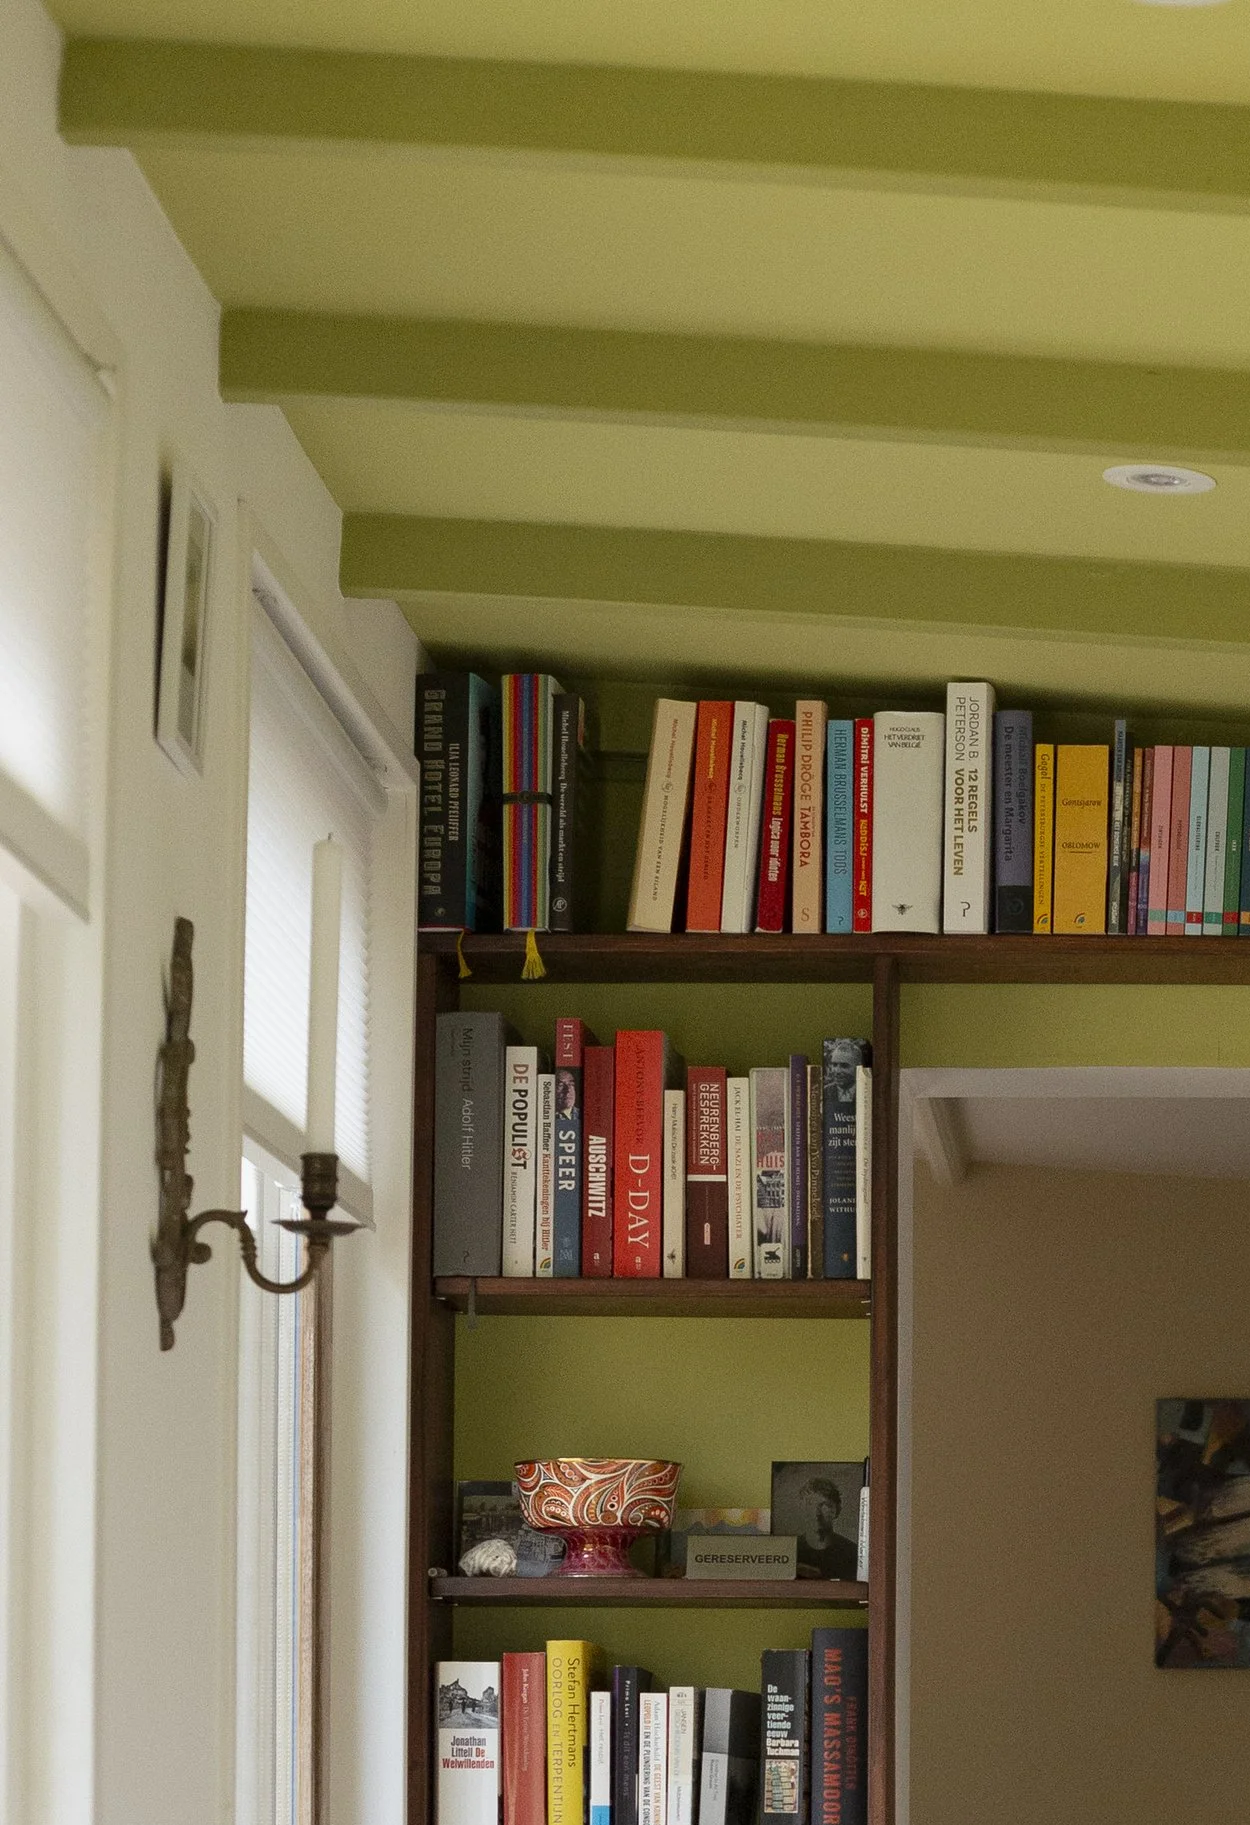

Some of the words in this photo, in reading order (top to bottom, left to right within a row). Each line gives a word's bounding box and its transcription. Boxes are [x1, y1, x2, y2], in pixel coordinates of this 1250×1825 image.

[560, 711, 570, 735] Michel
[800, 711, 813, 751] PHILIP
[953, 697, 965, 762] PETERSON
[967, 697, 979, 747] JORDAN
[1003, 727, 1014, 742] De
[448, 743, 460, 759] ILJA
[558, 736, 569, 780] Houellebecq
[834, 729, 847, 770] HERMAN
[968, 751, 978, 761] B.
[1037, 753, 1051, 779] Gogol
[448, 762, 460, 798] LEONARD
[559, 783, 567, 793] De
[799, 754, 816, 801] DRÖGE
[952, 768, 965, 805] VOOR
[967, 769, 978, 782] 12
[558, 794, 567, 818] wereld
[833, 774, 847, 845] BRUSSELMANS
[952, 811, 964, 833] HET
[967, 784, 978, 832] REGELS
[557, 831, 566, 852] markt
[558, 819, 566, 830] als
[799, 806, 812, 868] TAMBORA
[1001, 807, 1015, 863] Margarita
[557, 854, 564, 863] en
[833, 849, 846, 875] TOOS
[952, 835, 963, 876] LEVEN
[556, 864, 565, 883] strijd
[460, 1028, 475, 1058] Mijn
[562, 1024, 575, 1061] FEST
[460, 1060, 475, 1092] strijd
[512, 1063, 529, 1085] DE
[461, 1098, 475, 1133] Adolf
[542, 1081, 552, 1119] Sebastian
[542, 1122, 551, 1152] Haffner
[699, 1084, 710, 1164] GESPREKKEN
[709, 1083, 720, 1171] NEURENBERG-
[461, 1135, 475, 1170] Hitler
[557, 1130, 577, 1190] SPEER
[588, 1135, 606, 1218] AUSCHWITZ
[627, 1153, 651, 1249] D-DAY
[694, 1553, 790, 1565] GERESERVEERD
[552, 1657, 563, 1719] OORLOG
[567, 1657, 581, 1699] Stefan
[767, 1684, 778, 1693] De
[823, 1647, 841, 1704] MAO'S
[450, 1736, 487, 1746] Jonathan
[552, 1723, 560, 1737] EN
[567, 1703, 580, 1768] Hertmans
[766, 1730, 788, 1738] eeuw
[766, 1738, 800, 1747] Barbara
[475, 1747, 485, 1757] De
[552, 1742, 563, 1824] TERPENTIJN
